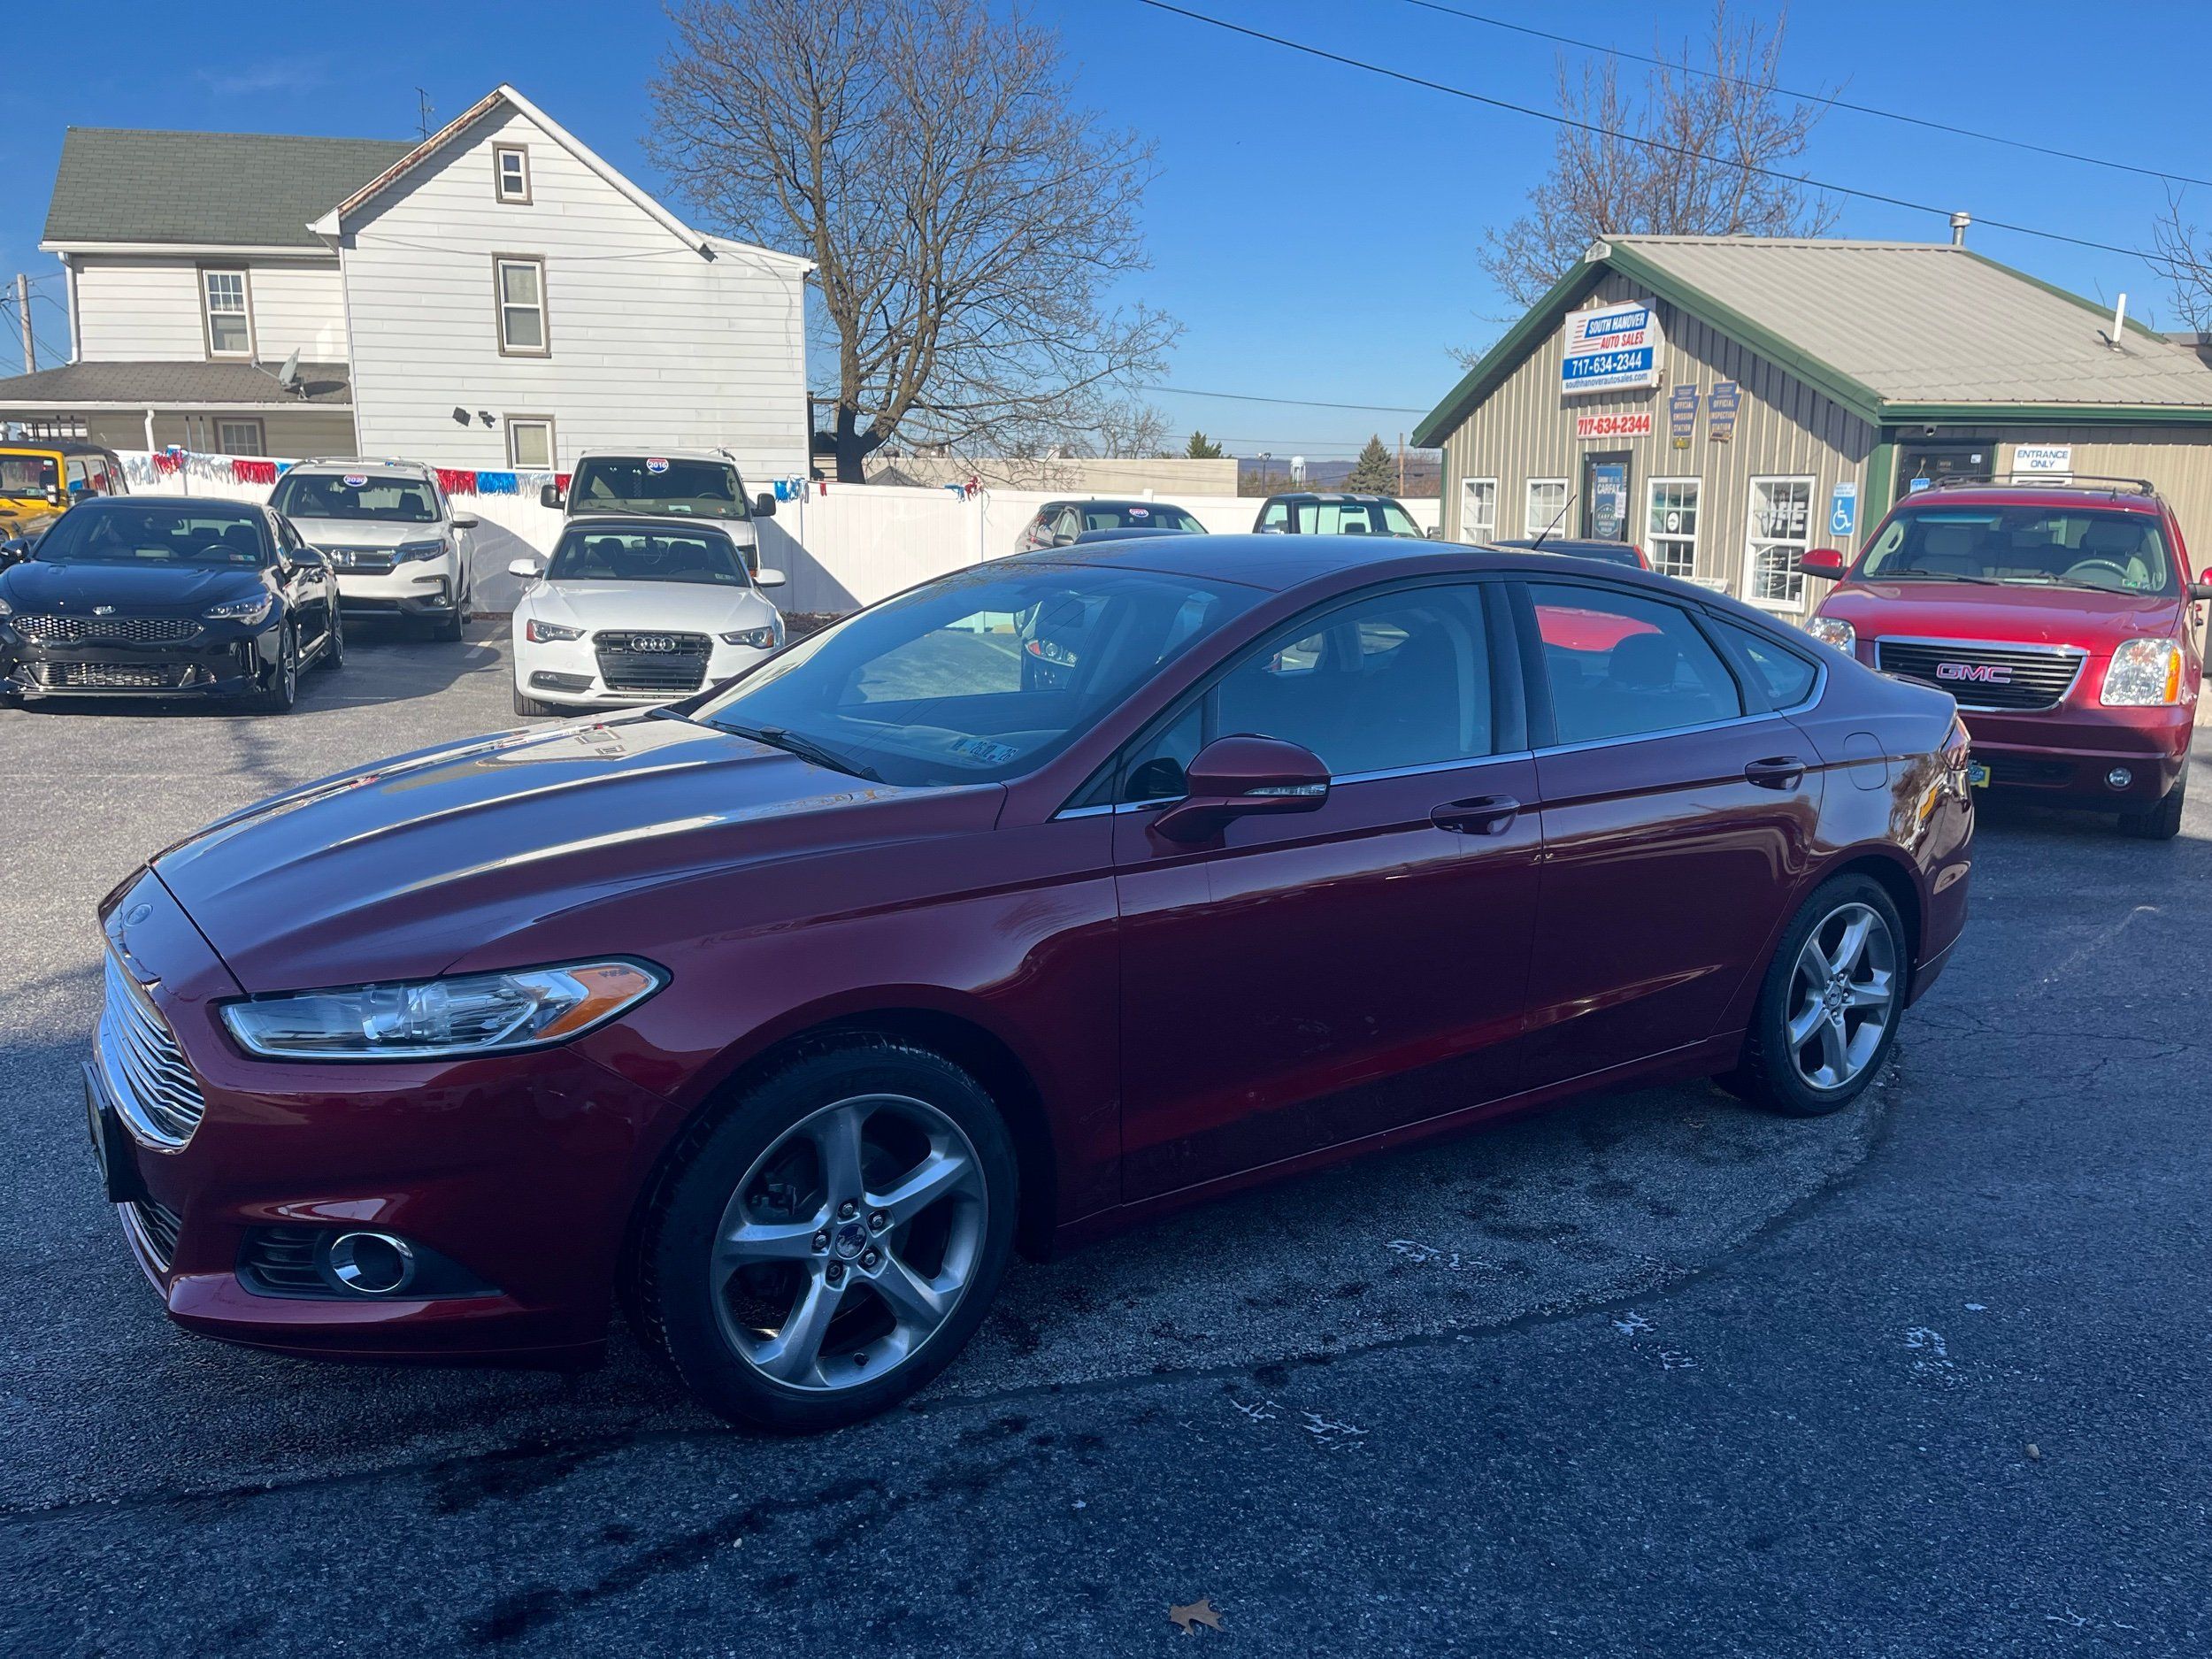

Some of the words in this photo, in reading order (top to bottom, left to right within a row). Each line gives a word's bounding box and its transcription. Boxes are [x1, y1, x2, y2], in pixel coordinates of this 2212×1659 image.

[1589, 317, 1611, 334] SOUTH
[1612, 311, 1646, 329] HANOVER
[1601, 334, 1620, 349] AUTO
[1621, 331, 1645, 347] SALES
[1572, 351, 1642, 376] 717-634-2344
[1565, 373, 1648, 389] southhanoverautosales.com
[1578, 414, 1650, 435] 717-634-2344
[2016, 449, 2069, 458] ENTRANCE
[2030, 459, 2055, 468] ONLY
[1596, 483, 1621, 495] CARFAX
[1936, 663, 2013, 684] GMC
